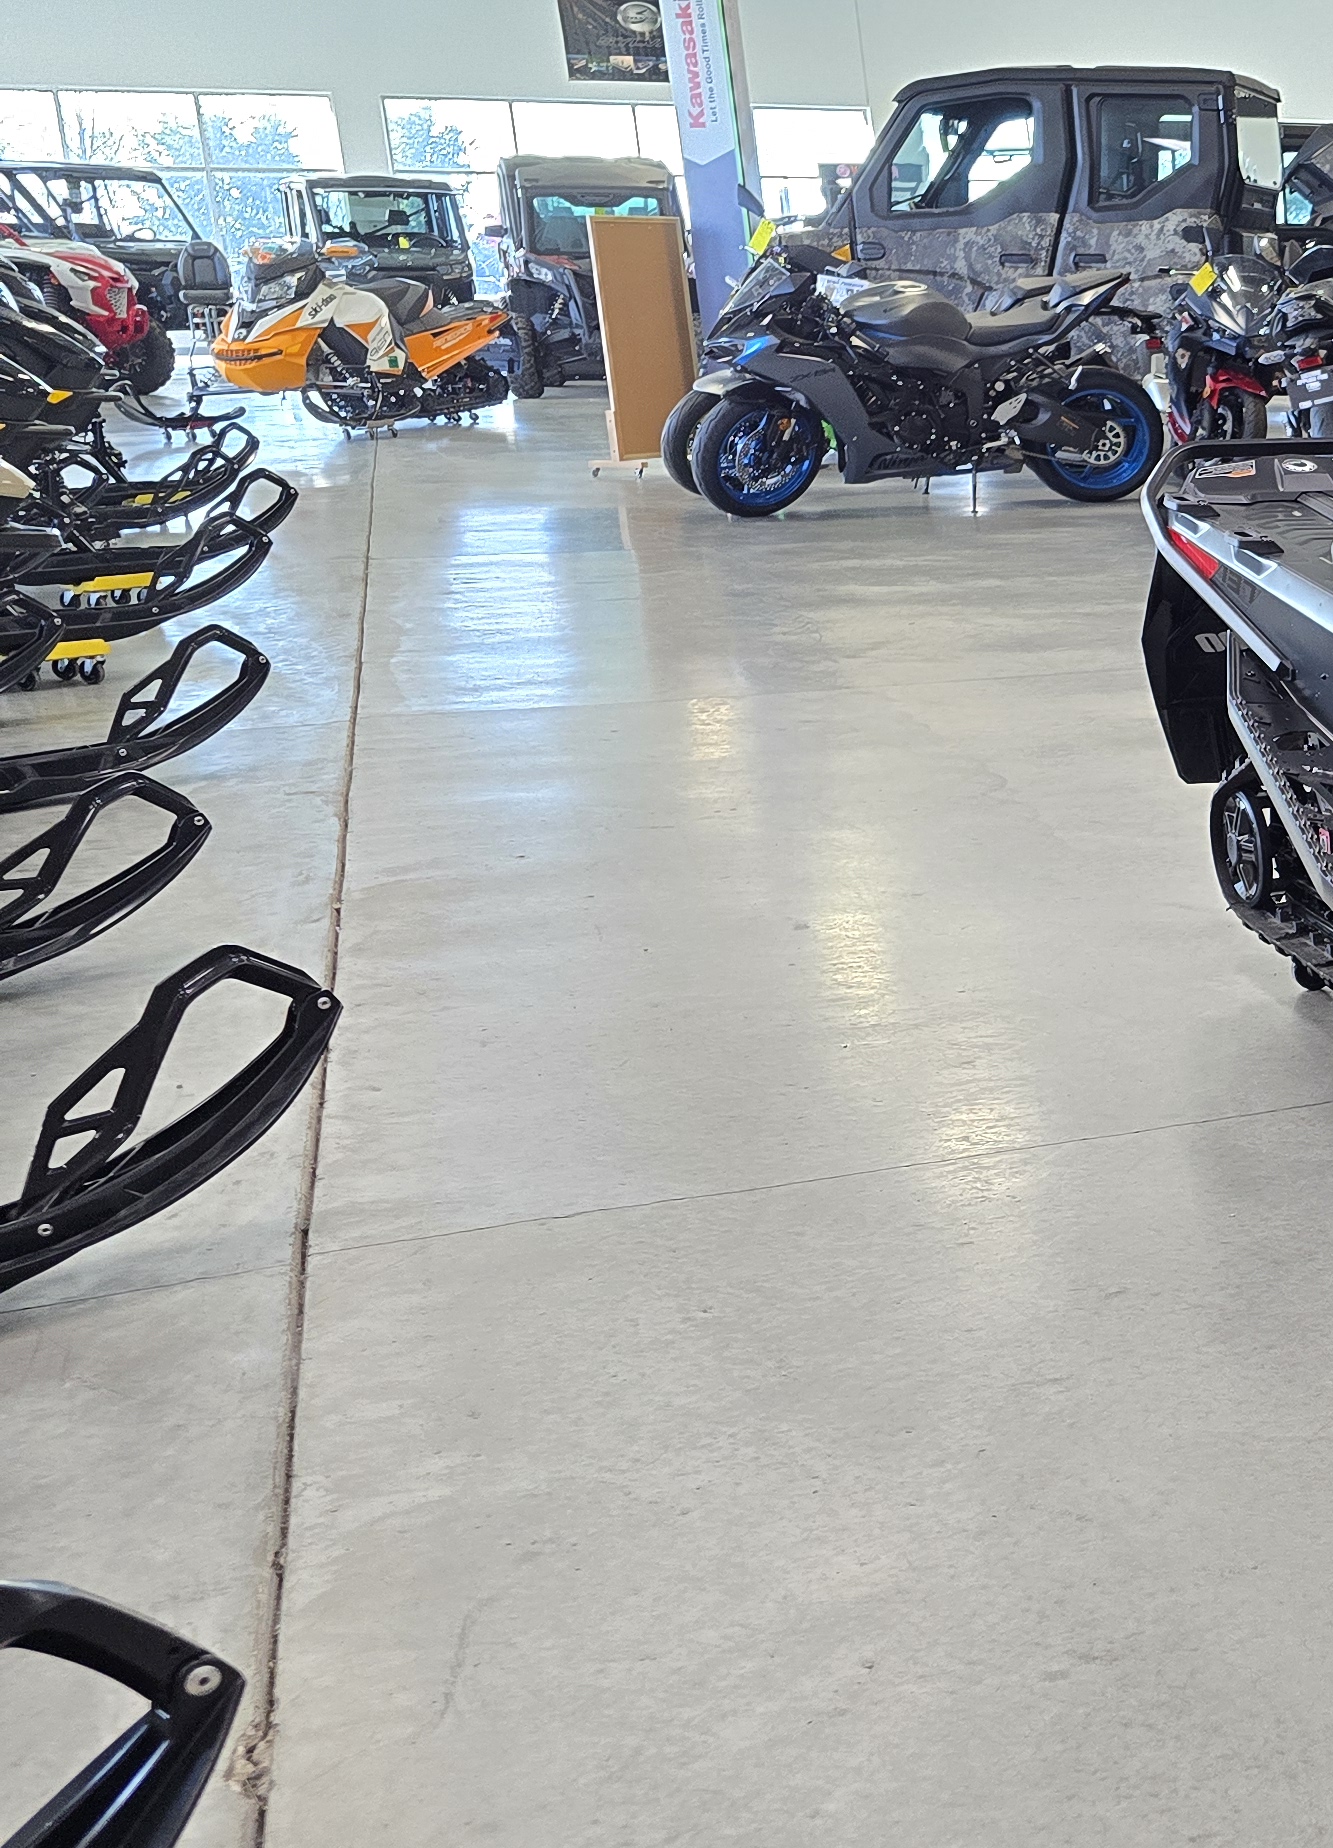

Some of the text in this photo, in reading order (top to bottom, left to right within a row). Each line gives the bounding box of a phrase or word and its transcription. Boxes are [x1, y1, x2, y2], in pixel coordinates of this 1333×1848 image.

[700, 23, 709, 54] Times
[673, 0, 707, 128] Kawasak
[703, 57, 713, 84] Good
[710, 106, 718, 123] Let
